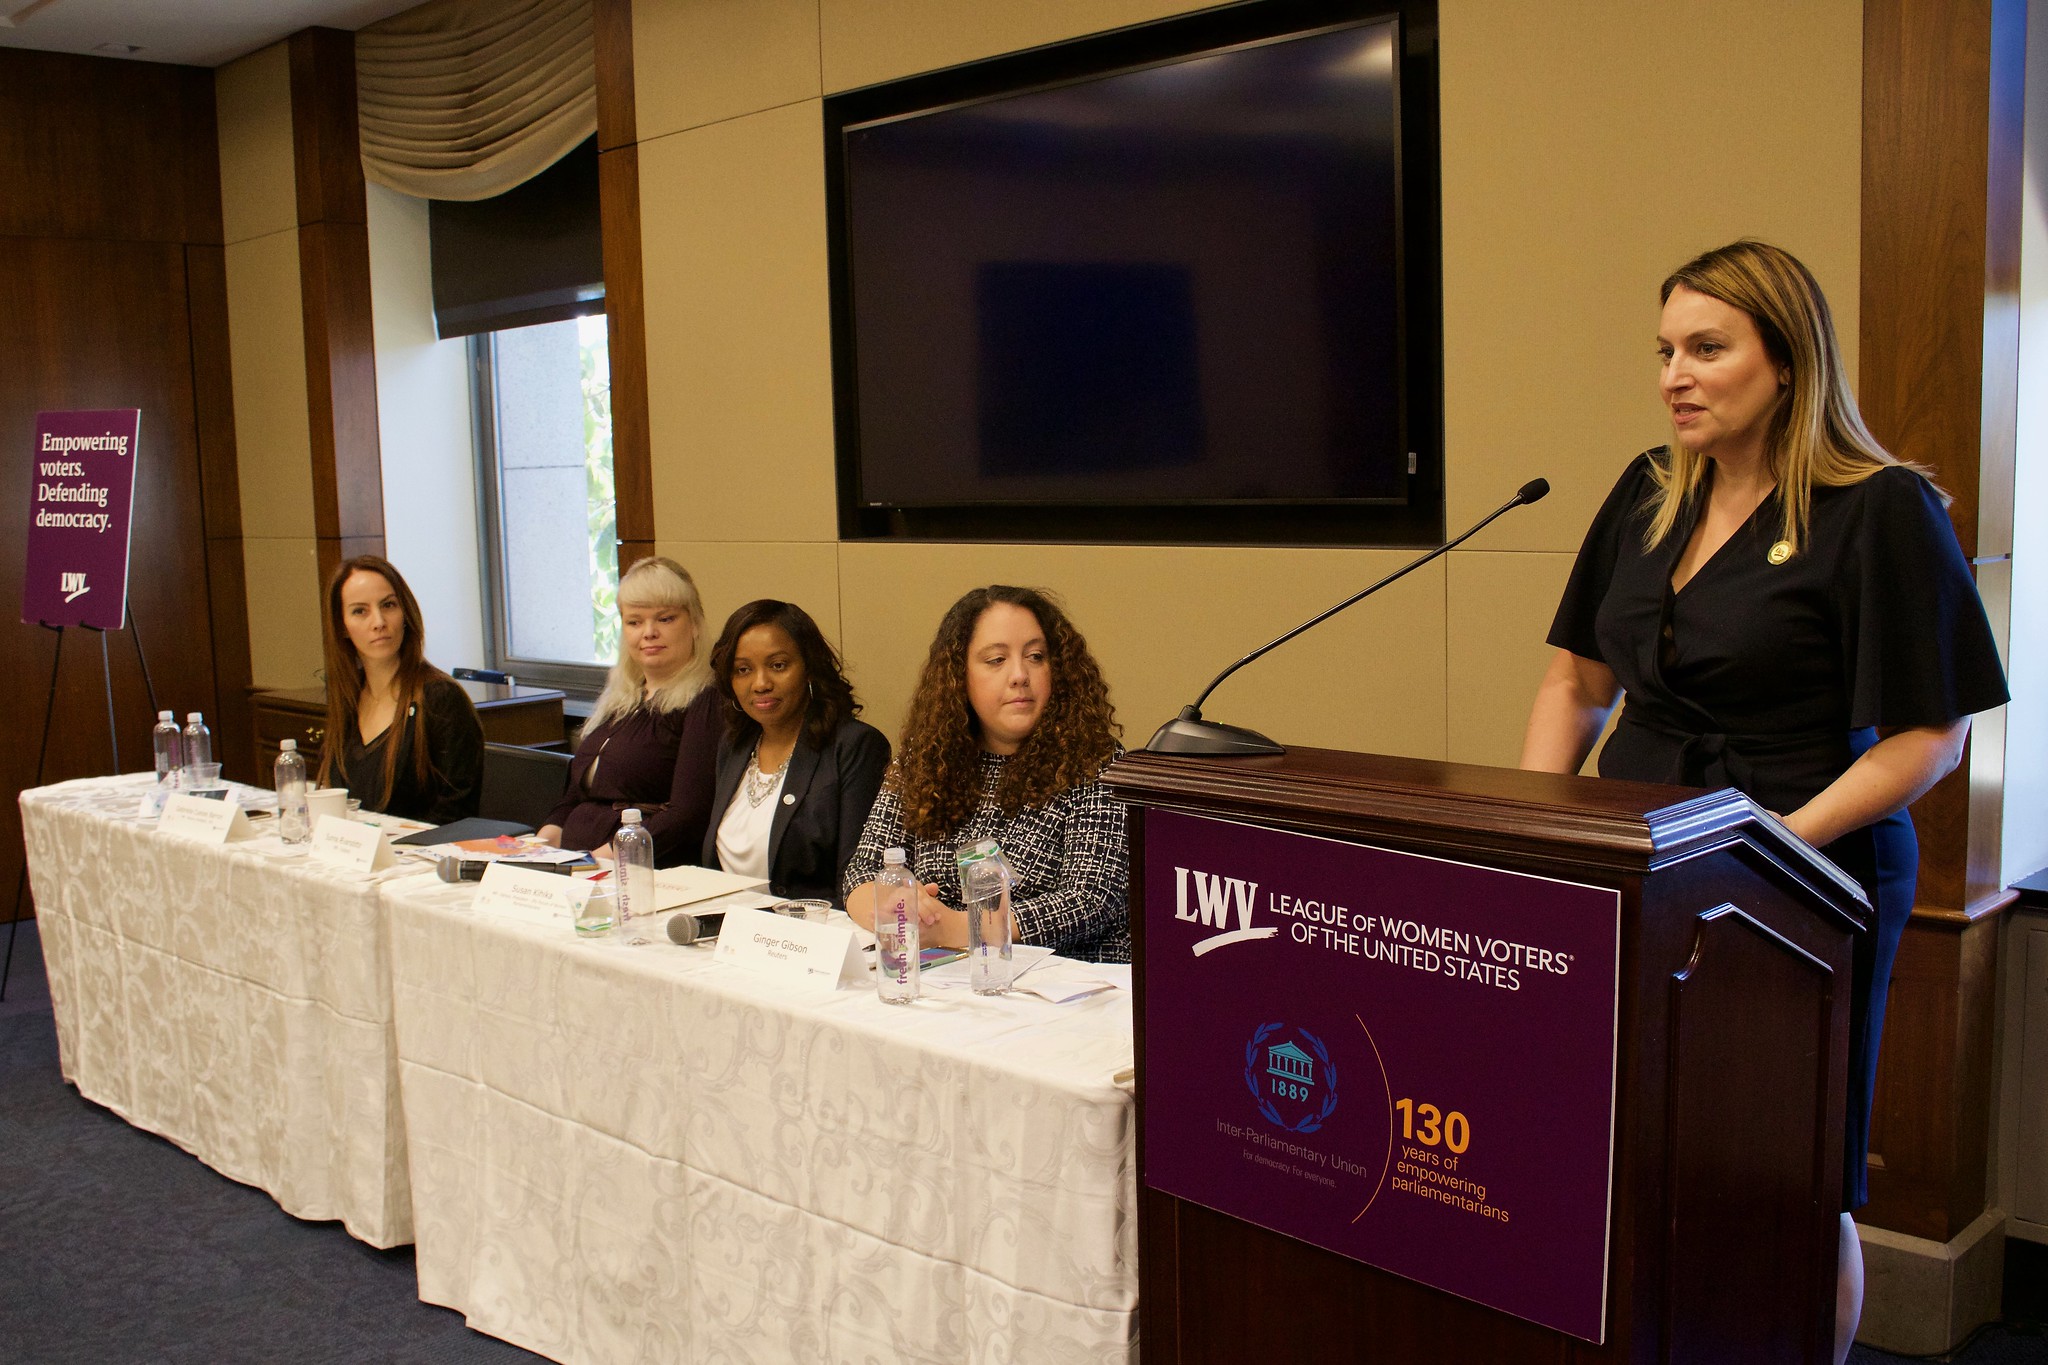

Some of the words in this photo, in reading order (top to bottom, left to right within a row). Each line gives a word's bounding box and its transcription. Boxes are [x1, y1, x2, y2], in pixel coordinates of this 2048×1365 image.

[42, 431, 128, 456] Empowering
[40, 460, 85, 477] voters.
[38, 482, 108, 507] Defending
[36, 508, 112, 533] democracy.
[61, 572, 87, 592] LWV
[511, 884, 532, 895] Susan
[1174, 866, 1258, 932] LWV
[894, 898, 908, 944] simple.
[1270, 892, 1348, 928] LEAGUE
[1353, 914, 1377, 933] OF
[1380, 915, 1469, 954] WOMEN
[753, 933, 780, 948] Ginger
[780, 939, 808, 954] Gibson
[767, 949, 788, 960] Reuters
[1291, 922, 1317, 945] OF
[1321, 927, 1359, 955] THE
[1364, 937, 1440, 972] UNITED
[1444, 955, 1520, 991] STATES
[895, 953, 907, 985] fresh
[1272, 1078, 1309, 1102] 1889
[1396, 1097, 1470, 1154] 130
[1216, 1117, 1327, 1167] Inter-Parliamentary
[1331, 1154, 1367, 1178] Union
[1402, 1145, 1440, 1170] years
[1444, 1156, 1458, 1171] of
[1243, 1149, 1253, 1160] For
[1292, 1164, 1303, 1177] For
[1397, 1161, 1486, 1200] empowering
[1392, 1175, 1509, 1222] parliamentarians
